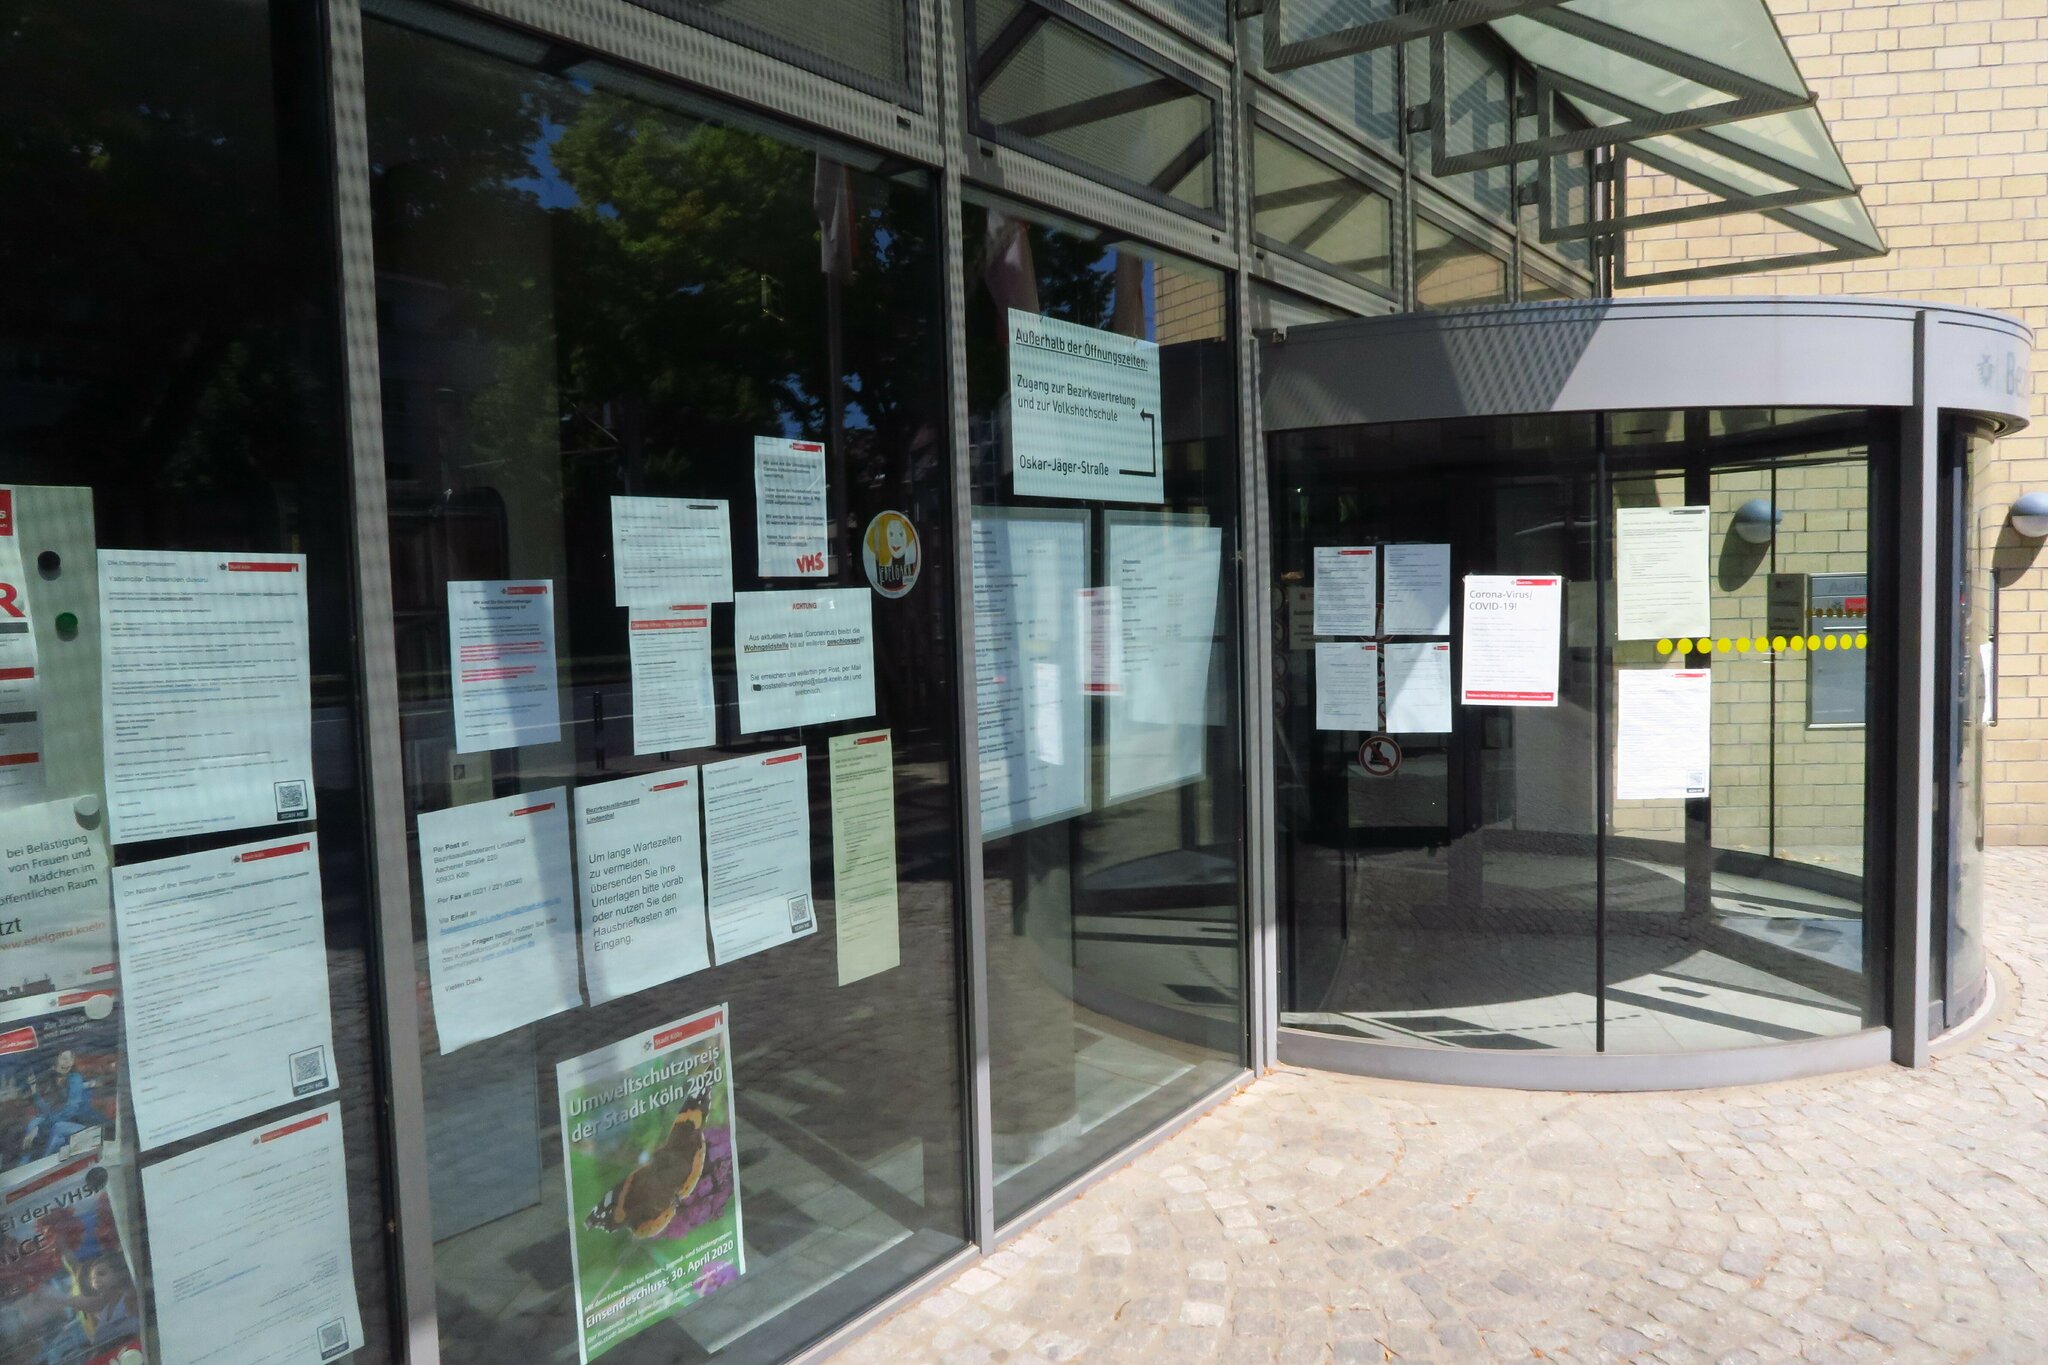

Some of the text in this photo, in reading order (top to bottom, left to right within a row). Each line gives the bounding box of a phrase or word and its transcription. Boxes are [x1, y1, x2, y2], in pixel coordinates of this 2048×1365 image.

[1015, 327, 1149, 371] Außerhalb der Öffnungszeiten:
[1017, 374, 1136, 410] Zugang zur Bezirksvertretung
[1018, 397, 1118, 422] und zur Volkshochschule
[1019, 455, 1109, 476] Oskar-Jäger-Straße
[796, 552, 824, 574] VHS
[1469, 601, 1518, 611] COVID-19!
[743, 642, 789, 654] Wohngeldstelle
[7, 834, 89, 859] bei Belästigung
[445, 841, 460, 850] Post
[588, 834, 682, 865] Um lange Wartezeiten
[8, 848, 92, 873] von Frauen und
[589, 857, 651, 879] zu vermeiden,
[28, 863, 95, 885] Mädchen im
[67, 877, 98, 891] Raum
[590, 864, 676, 894] übersenden Sie Ihre
[591, 876, 684, 908] Unterlagen bitte vorab
[450, 912, 469, 922] Email
[592, 892, 677, 923] oder nutzen Sie den
[593, 906, 678, 937] Hausbriefkasten am
[472, 935, 494, 947] Fragen
[594, 935, 634, 952] Eingang.
[654, 1031, 683, 1046] Stadt Köln
[569, 1045, 720, 1117] Umweltschutzpreis
[571, 1068, 724, 1143] der Stadt Köln 2020
[20, 1202, 51, 1225] der
[585, 1239, 734, 1329] Einsendeschluss: 30. April 2020
